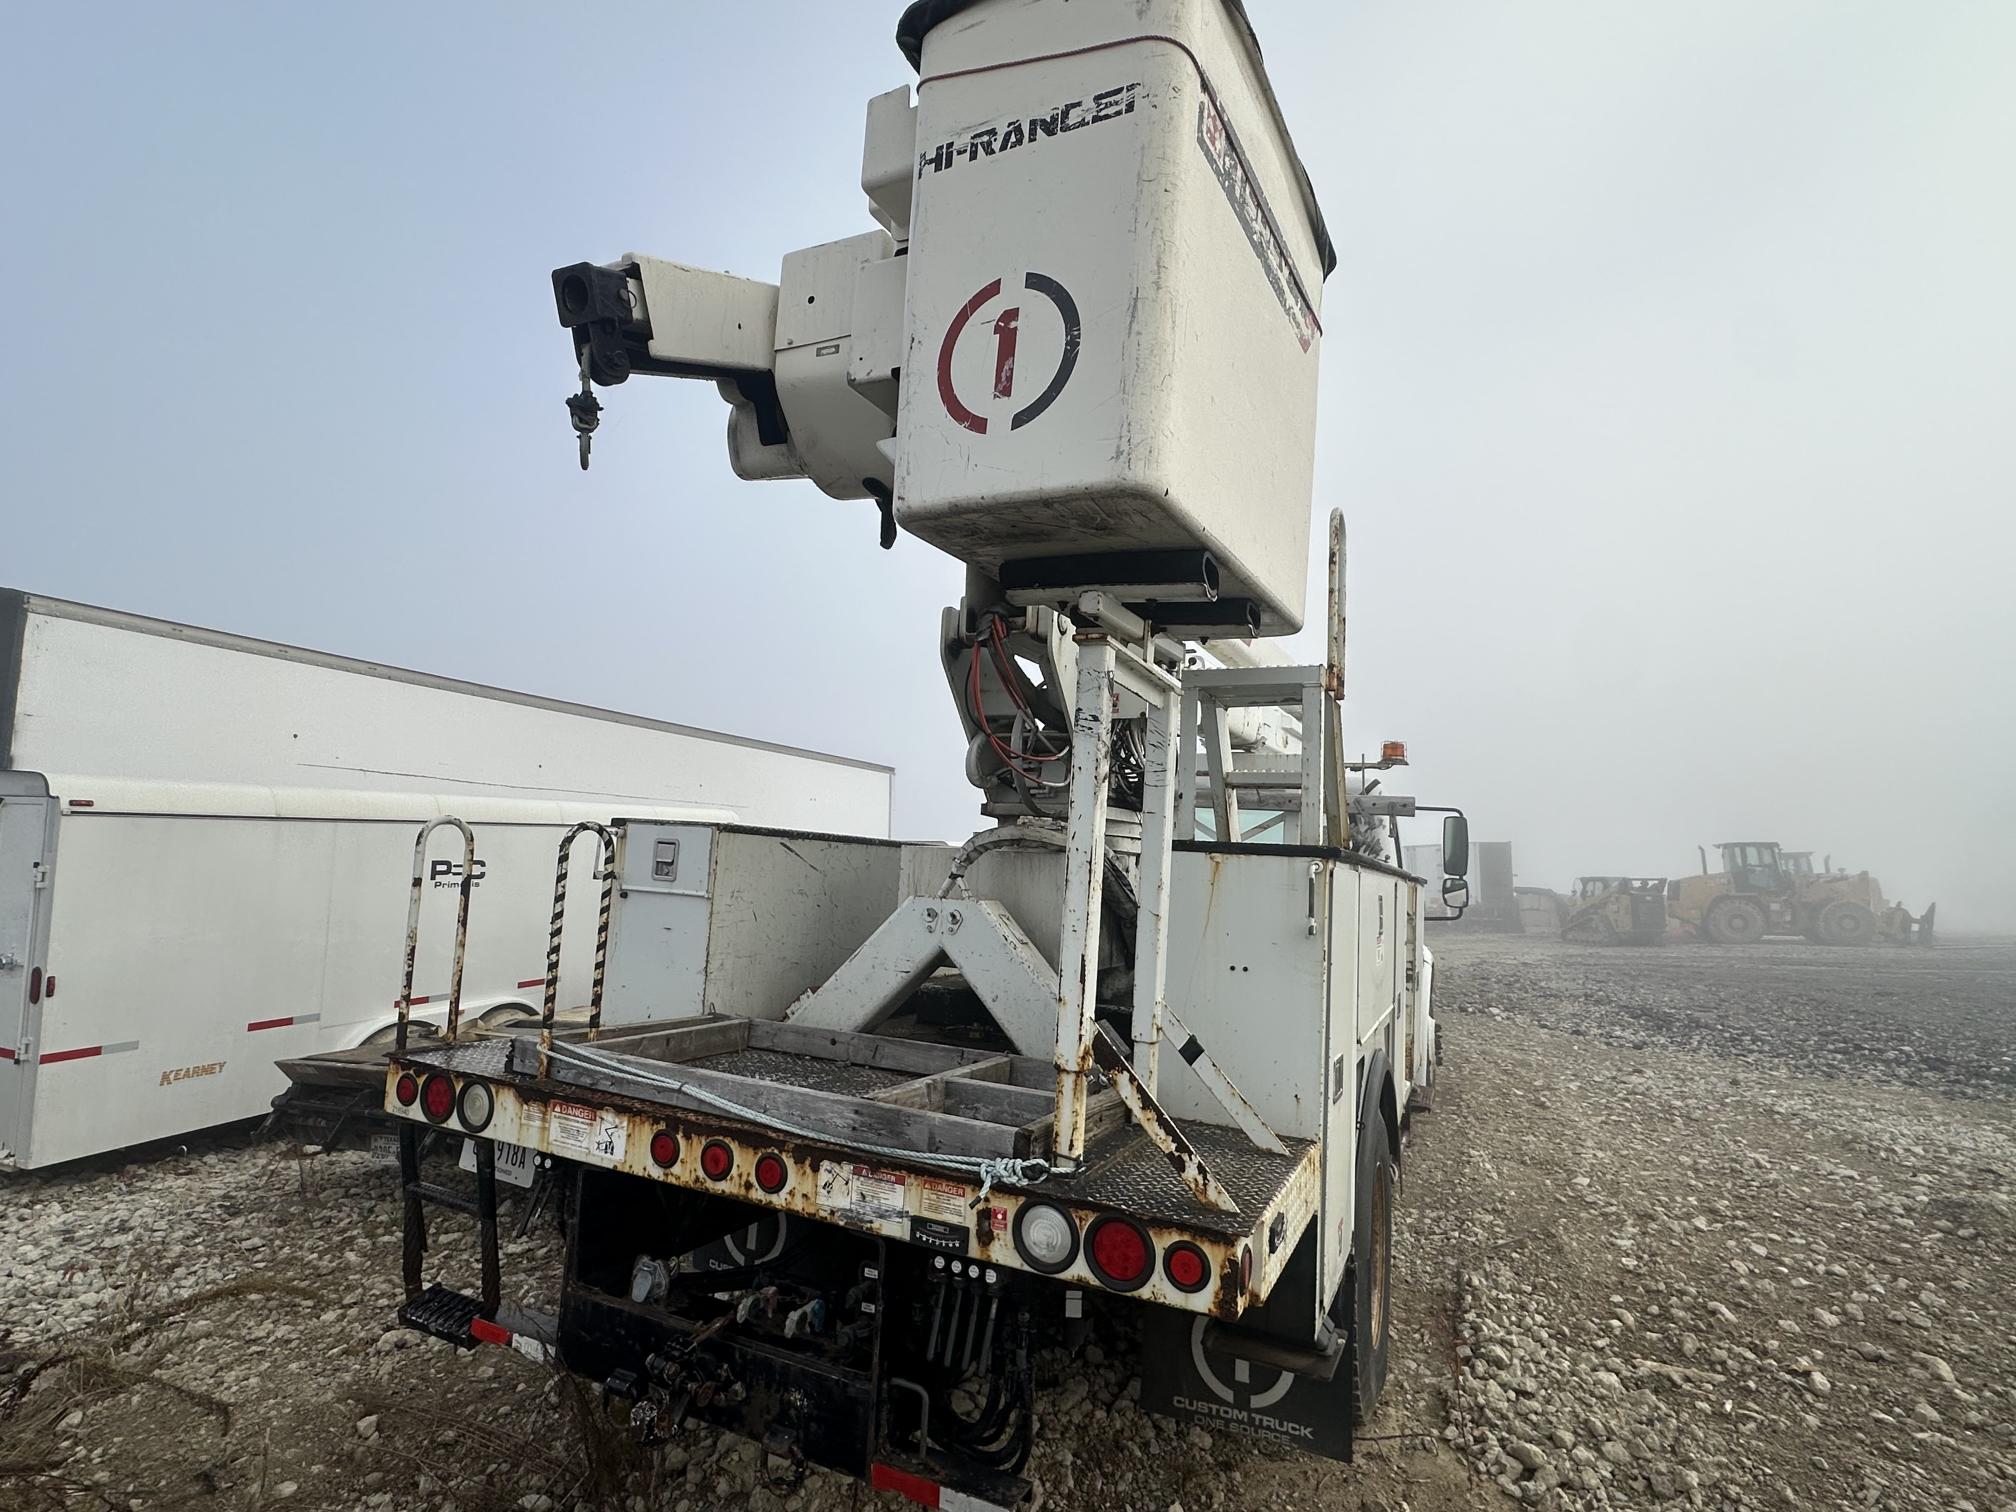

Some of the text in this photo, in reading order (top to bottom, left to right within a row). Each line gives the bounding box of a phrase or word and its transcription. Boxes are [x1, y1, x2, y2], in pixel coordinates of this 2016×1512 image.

[159, 1061, 227, 1087] KEARNEY
[931, 1182, 964, 1196] DANGER
[1172, 1395, 1315, 1440] CUSTOM TRUCK
[1193, 1415, 1292, 1445] ONE SOURCE
